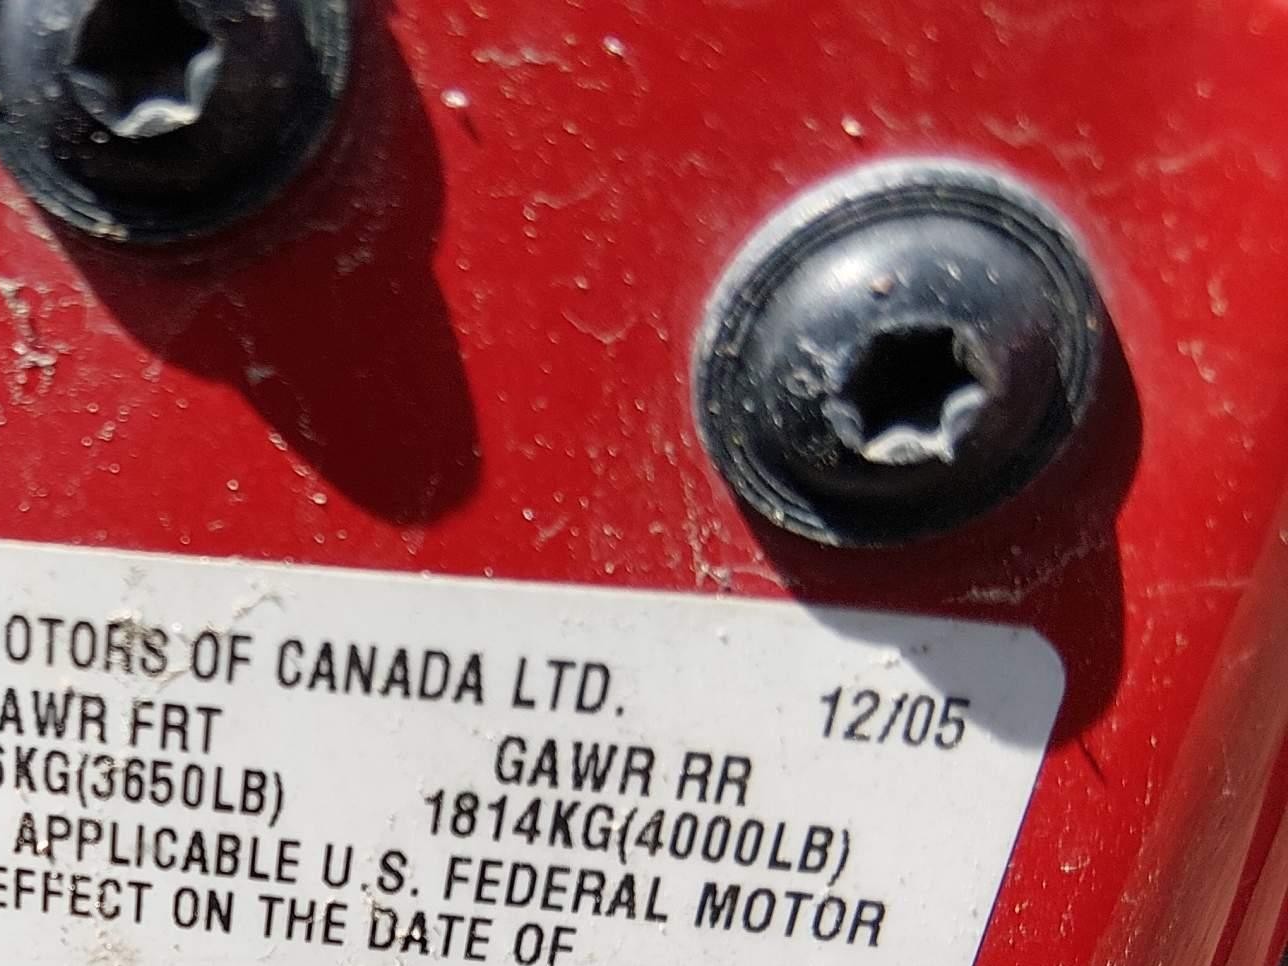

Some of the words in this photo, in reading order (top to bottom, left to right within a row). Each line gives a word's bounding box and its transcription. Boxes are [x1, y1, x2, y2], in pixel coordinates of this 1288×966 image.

[191, 629, 252, 684] OF
[278, 638, 485, 704] CANADA
[513, 658, 625, 717] LTD.
[130, 699, 223, 754] FRT
[819, 686, 971, 750] 12/05
[495, 736, 656, 797] GAWR
[676, 753, 753, 806] RR
[424, 789, 851, 887] 1814KG(4000LB)
[14, 813, 300, 884] APPLICABLE
[322, 844, 419, 898] U.S.
[444, 856, 669, 922] FEDERAL
[695, 882, 887, 948] MOTOR
[173, 887, 235, 932] ON
[260, 897, 348, 946] THE
[369, 907, 492, 962] DATE
